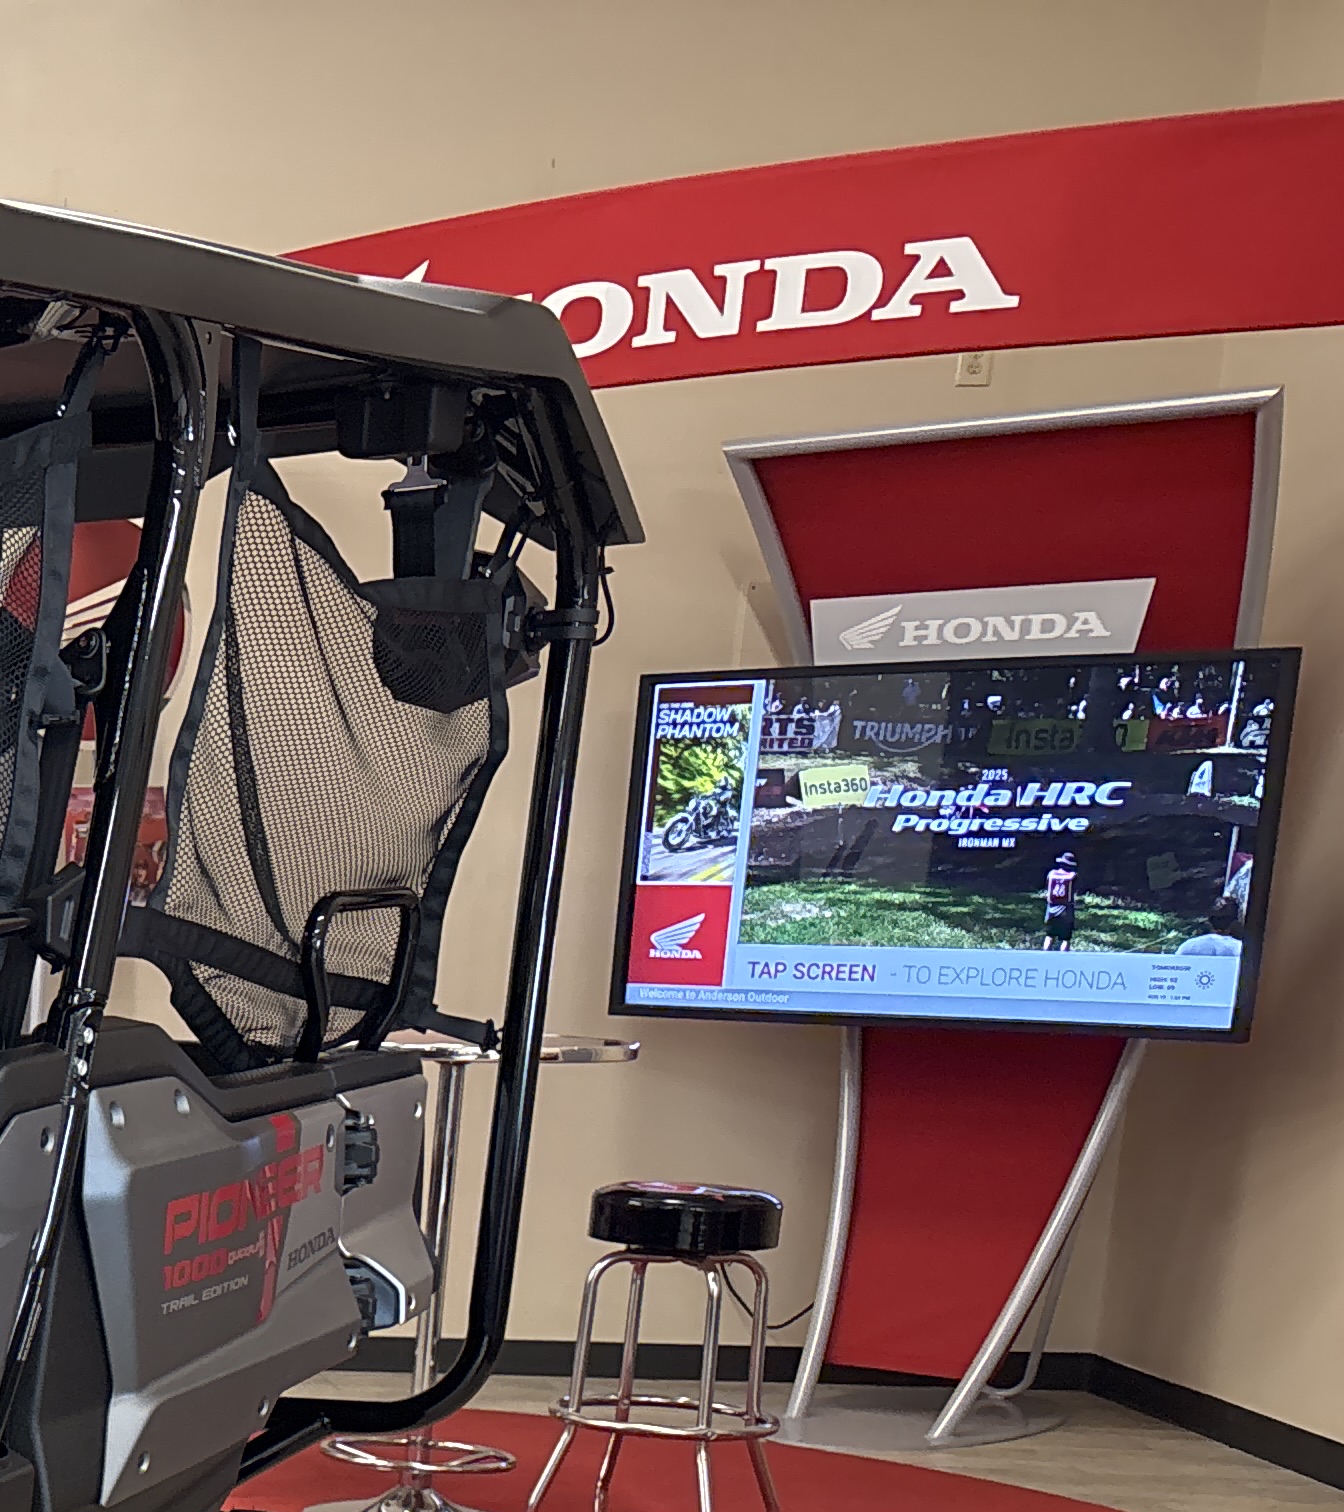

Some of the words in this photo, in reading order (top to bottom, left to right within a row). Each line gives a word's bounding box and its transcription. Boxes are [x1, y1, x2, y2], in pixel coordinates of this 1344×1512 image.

[512, 236, 1019, 359] ONDA
[899, 611, 1111, 646] HONDA
[658, 706, 732, 723] SHADOW
[656, 722, 739, 739] PHANTOM
[853, 720, 952, 744] TRIUMPH
[982, 768, 1009, 781] 2025
[803, 777, 868, 797] Insta360
[863, 783, 1012, 807] Honda
[1020, 781, 1132, 807] HRC
[891, 814, 1090, 835] Progressive
[957, 837, 999, 848] IRONMAN
[1002, 837, 1016, 848] MX
[649, 948, 703, 959] HONDA
[748, 961, 787, 980] TAP
[793, 962, 876, 982] SCREEN
[903, 964, 931, 984] TO
[938, 966, 1037, 989] EXPLORE
[1044, 970, 1127, 991] HONDA
[639, 987, 685, 999] Welcome
[685, 990, 696, 1000] to
[697, 989, 746, 1002] Anderson
[748, 991, 790, 1004] Outdoor
[164, 1144, 324, 1256] PIONEER
[286, 1226, 336, 1272] HONDA
[163, 1248, 228, 1292] 1000
[161, 1294, 200, 1315] TRAIL
[201, 1274, 249, 1301] EDITION
